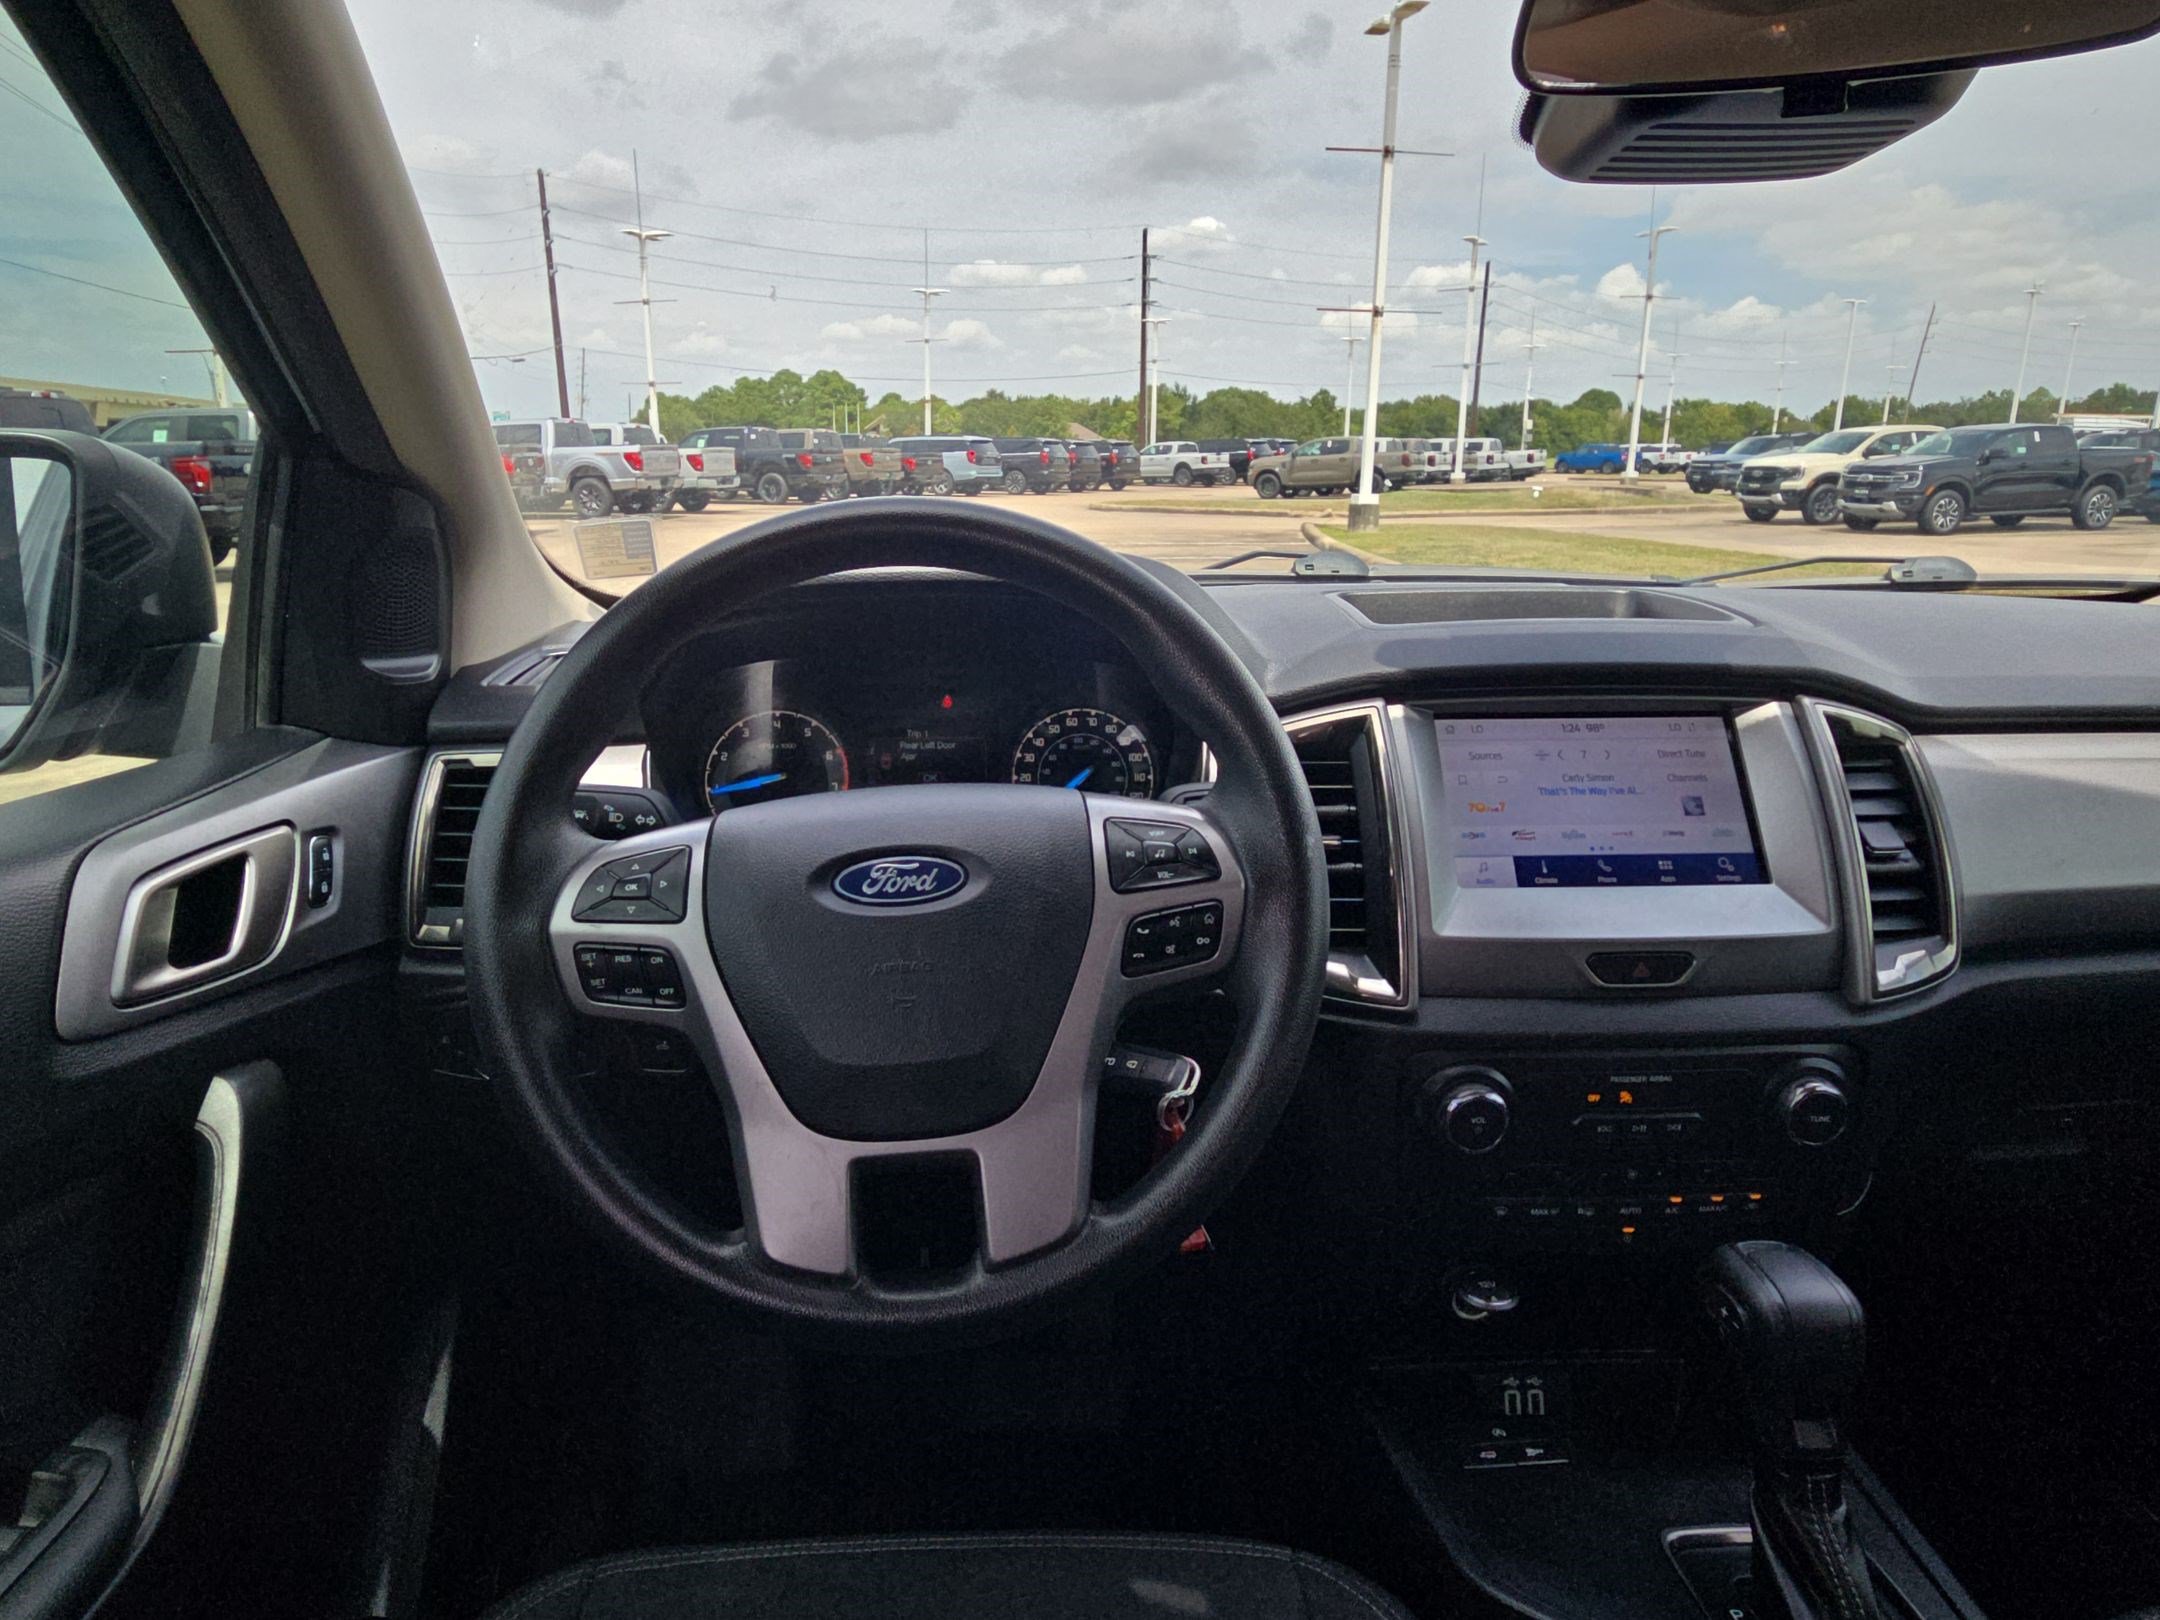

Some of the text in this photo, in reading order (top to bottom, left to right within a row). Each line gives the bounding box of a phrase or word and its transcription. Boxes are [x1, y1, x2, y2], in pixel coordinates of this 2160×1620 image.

[773, 720, 781, 729] 4
[1066, 717, 1078, 727] 60
[1087, 717, 1098, 727] 70
[742, 728, 749, 737] 3
[804, 728, 811, 737] 5
[1049, 725, 1060, 734] 50
[1105, 725, 1117, 734] 80
[1561, 723, 1581, 733] 1:24
[937, 741, 956, 749] Door
[1033, 737, 1045, 747] 40
[721, 752, 728, 761] 2
[826, 752, 833, 761] 6
[1024, 753, 1035, 762] 30
[1129, 753, 1143, 762] 100
[1468, 751, 1503, 761] Sources
[1020, 773, 1032, 782] 20
[1667, 773, 1708, 782] Channels
[862, 862, 939, 895] Ford
[1729, 1609, 1744, 1620] P
